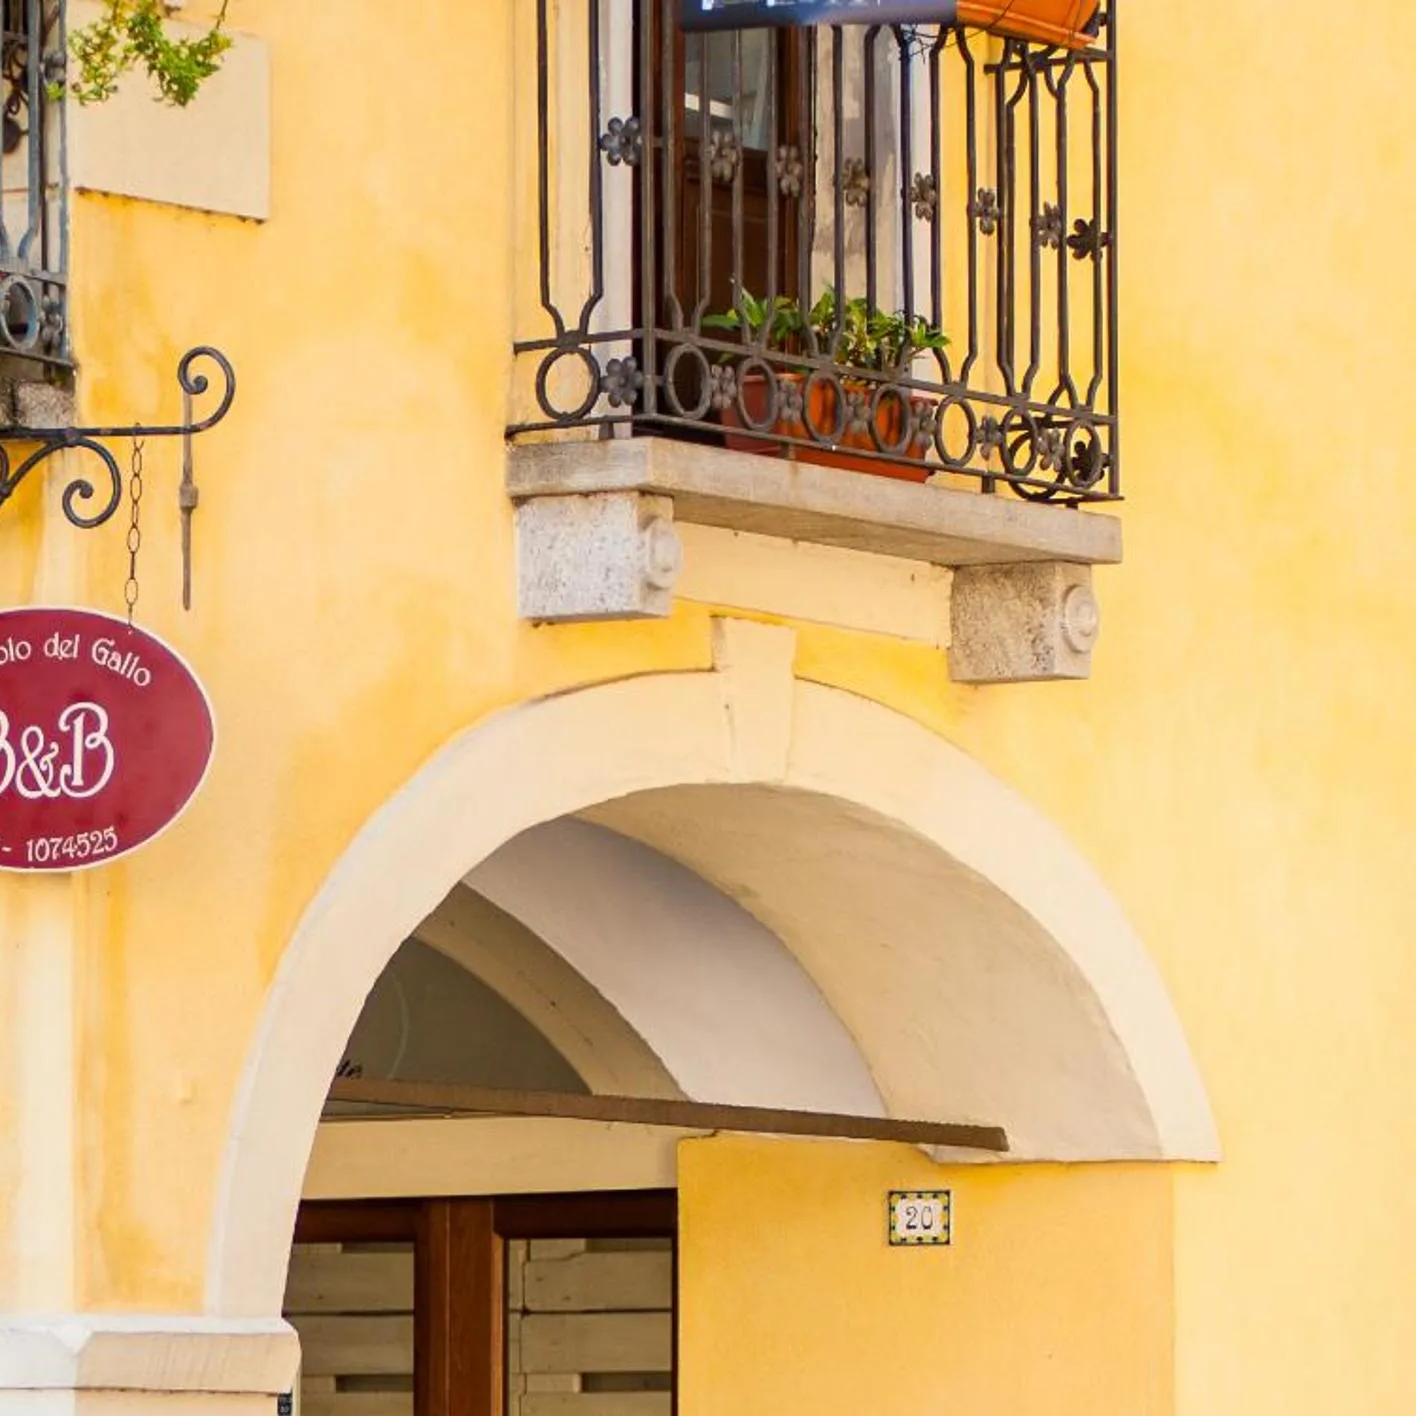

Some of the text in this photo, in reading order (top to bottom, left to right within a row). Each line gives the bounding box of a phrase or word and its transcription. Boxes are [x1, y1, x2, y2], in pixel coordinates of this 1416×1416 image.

[43, 632, 80, 661] del
[91, 638, 152, 687] Gallo
[26, 826, 118, 862] 1074525
[905, 1206, 934, 1230] 20
